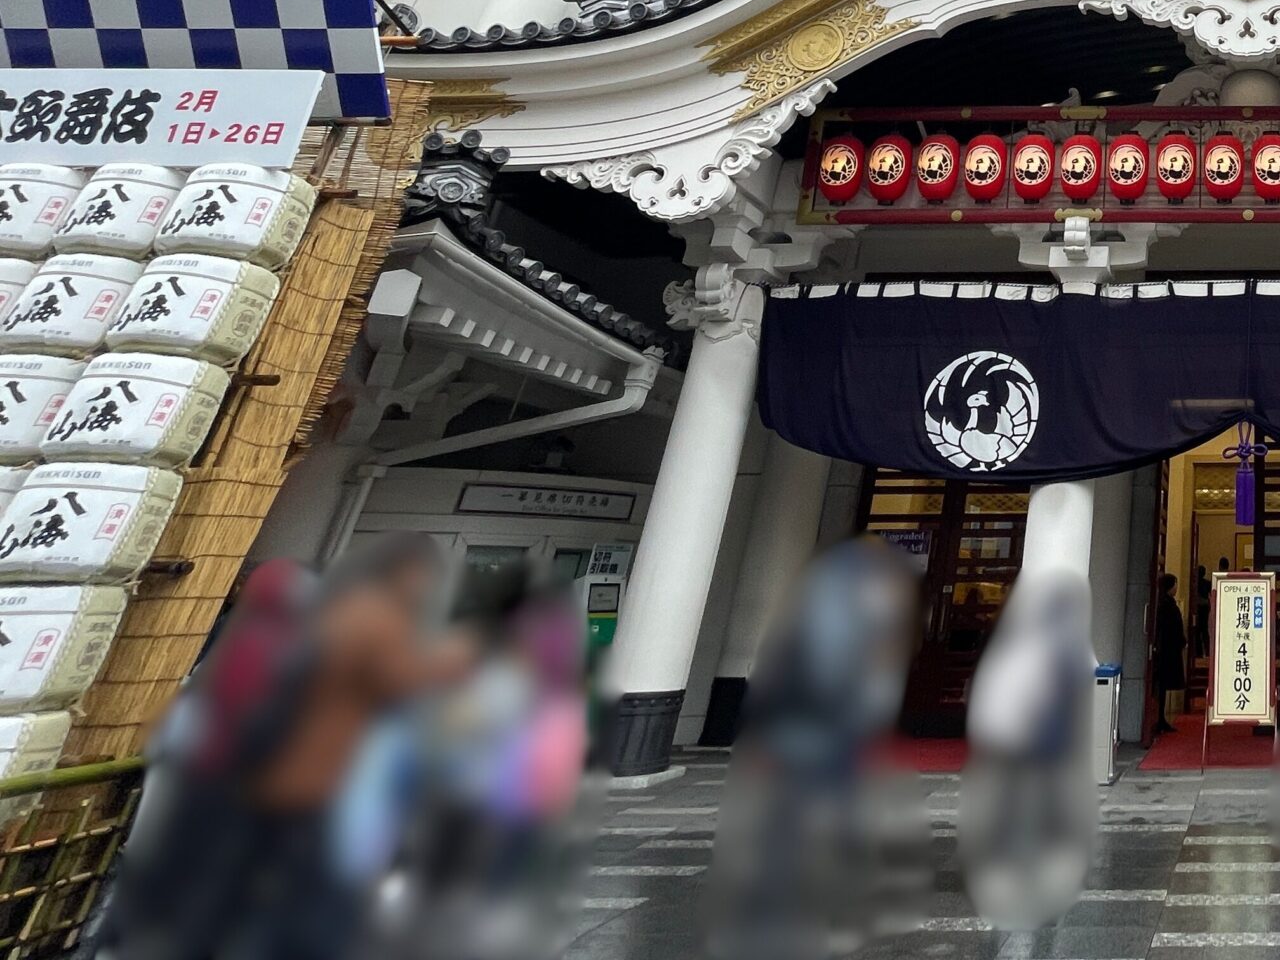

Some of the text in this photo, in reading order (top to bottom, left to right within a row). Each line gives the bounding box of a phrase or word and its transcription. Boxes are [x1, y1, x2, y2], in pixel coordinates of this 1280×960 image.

[176, 90, 218, 113] 2月
[161, 184, 238, 235] 八海山
[48, 380, 139, 441] 八海山
[1224, 585, 1242, 593] OPEN
